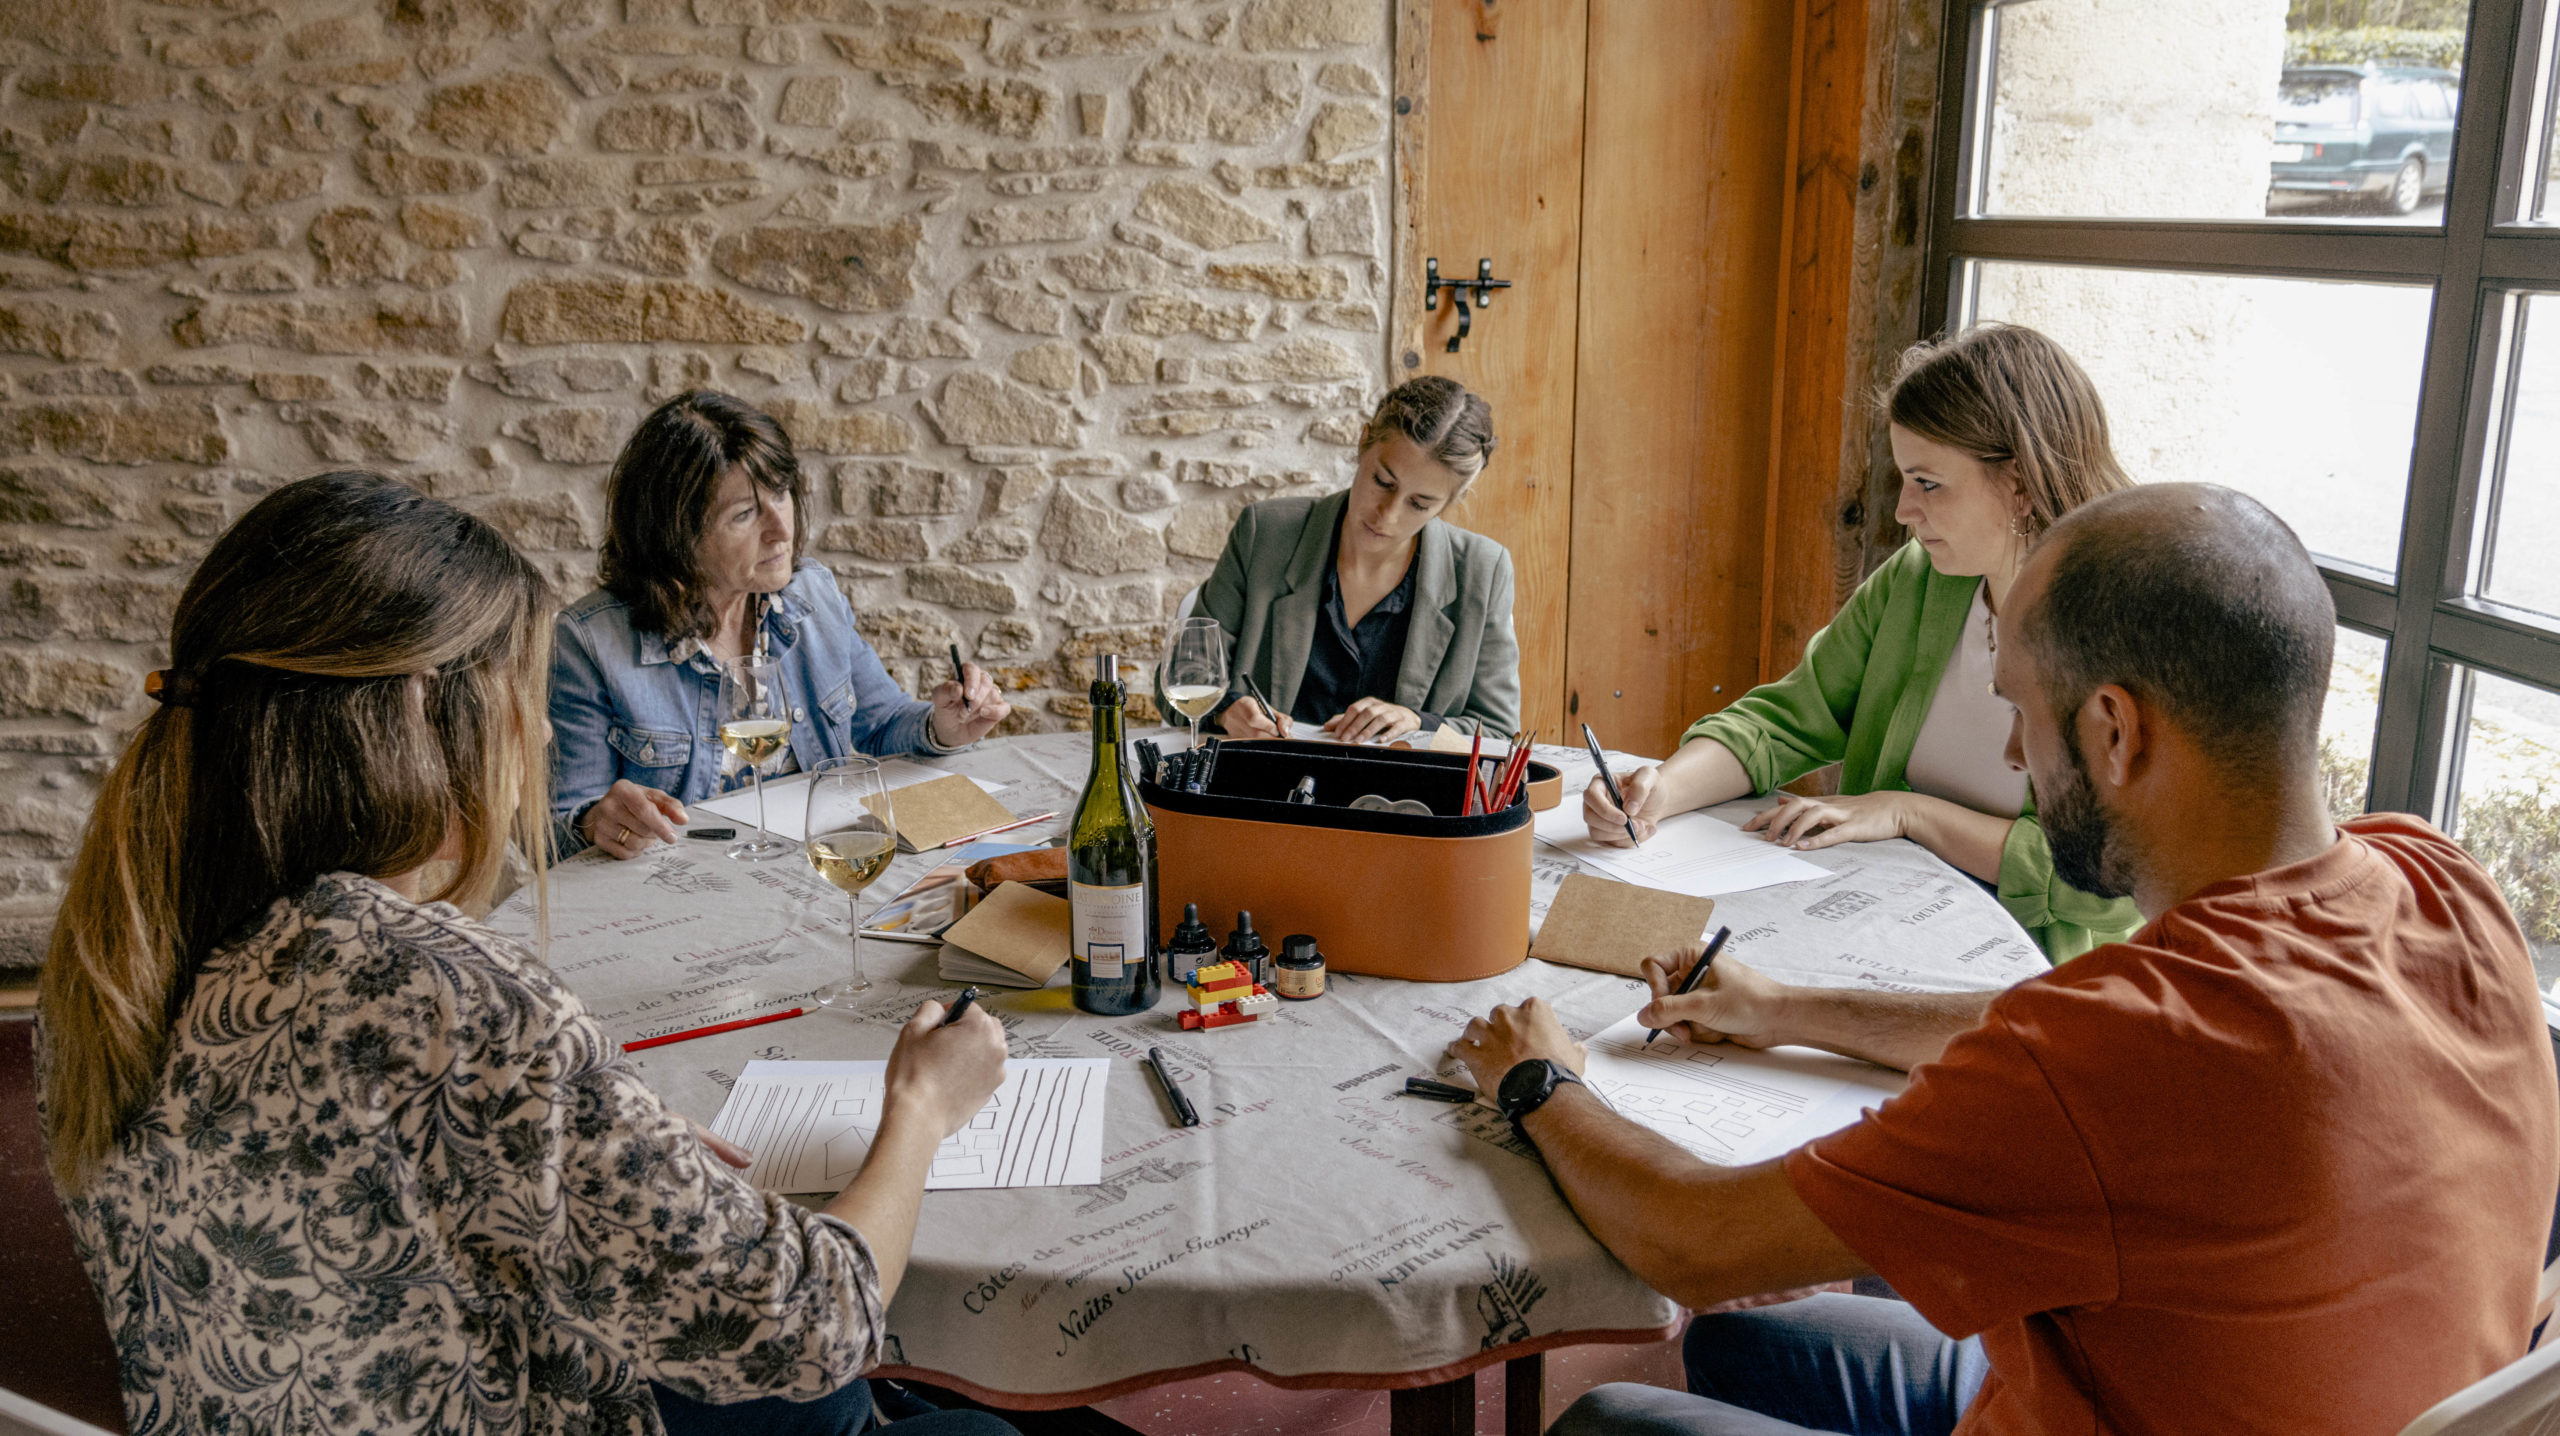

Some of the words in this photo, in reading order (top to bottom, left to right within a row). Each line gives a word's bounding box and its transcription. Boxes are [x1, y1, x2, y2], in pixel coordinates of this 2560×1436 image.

[592, 913, 656, 931] VENT
[620, 914, 704, 936] BROUILLY
[1899, 896, 1955, 928] VOUVRAY
[1956, 936, 2009, 964] BROUILLY
[600, 1009, 630, 1022] tes
[667, 973, 762, 1002] Proven
[1101, 1122, 1196, 1167] teauneuf
[962, 1260, 1027, 1316] Côtes
[1032, 1245, 1065, 1262] de
[1064, 1201, 1178, 1248] Provence
[1055, 1290, 1113, 1358] Nuits
[1116, 1214, 1272, 1295] Saint-Georges
